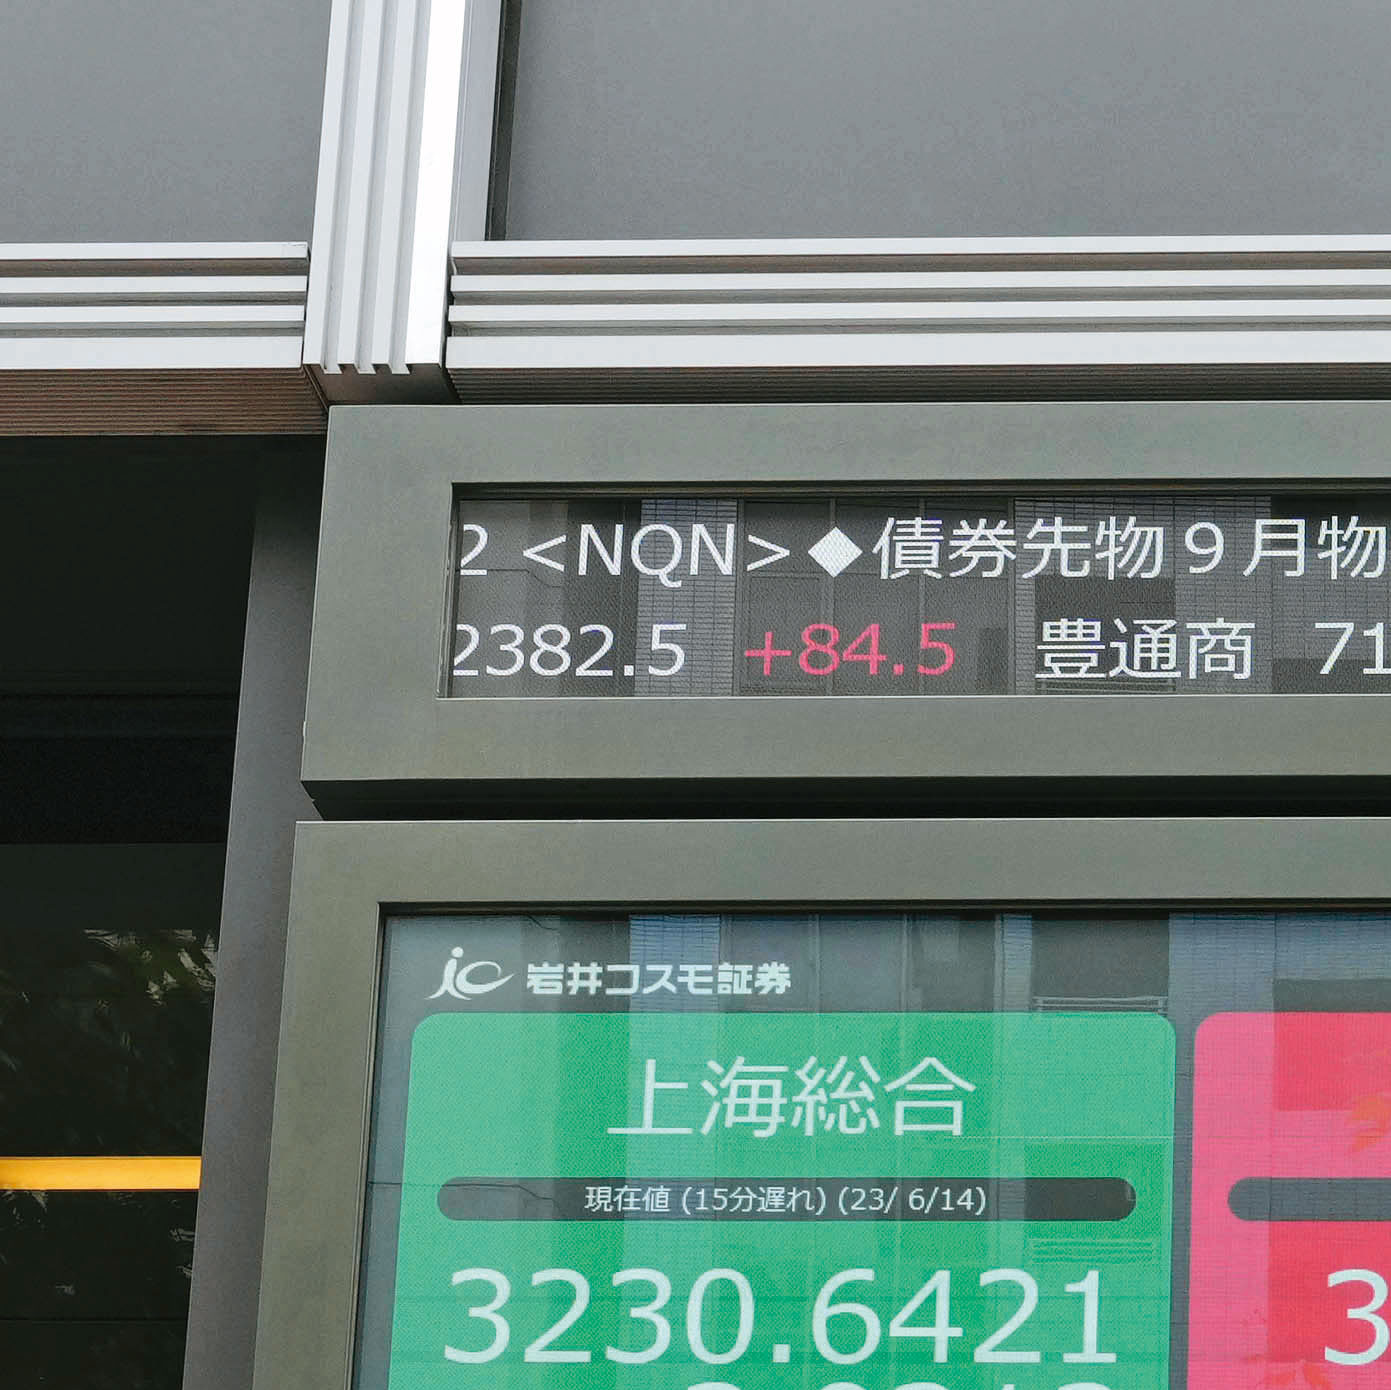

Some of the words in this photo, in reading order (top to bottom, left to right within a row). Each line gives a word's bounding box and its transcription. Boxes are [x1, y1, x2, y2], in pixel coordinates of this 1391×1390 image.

[452, 623, 687, 677] 2382.5
[745, 623, 956, 676] +84.5
[1034, 617, 1256, 680] 豊通商
[526, 961, 792, 995] 岩井コスモ証券
[606, 1055, 977, 1139] 上海総合
[584, 1184, 672, 1212] 現在値
[681, 1186, 826, 1216] (15分遅れ)
[443, 1265, 1118, 1365] 3230.6421
